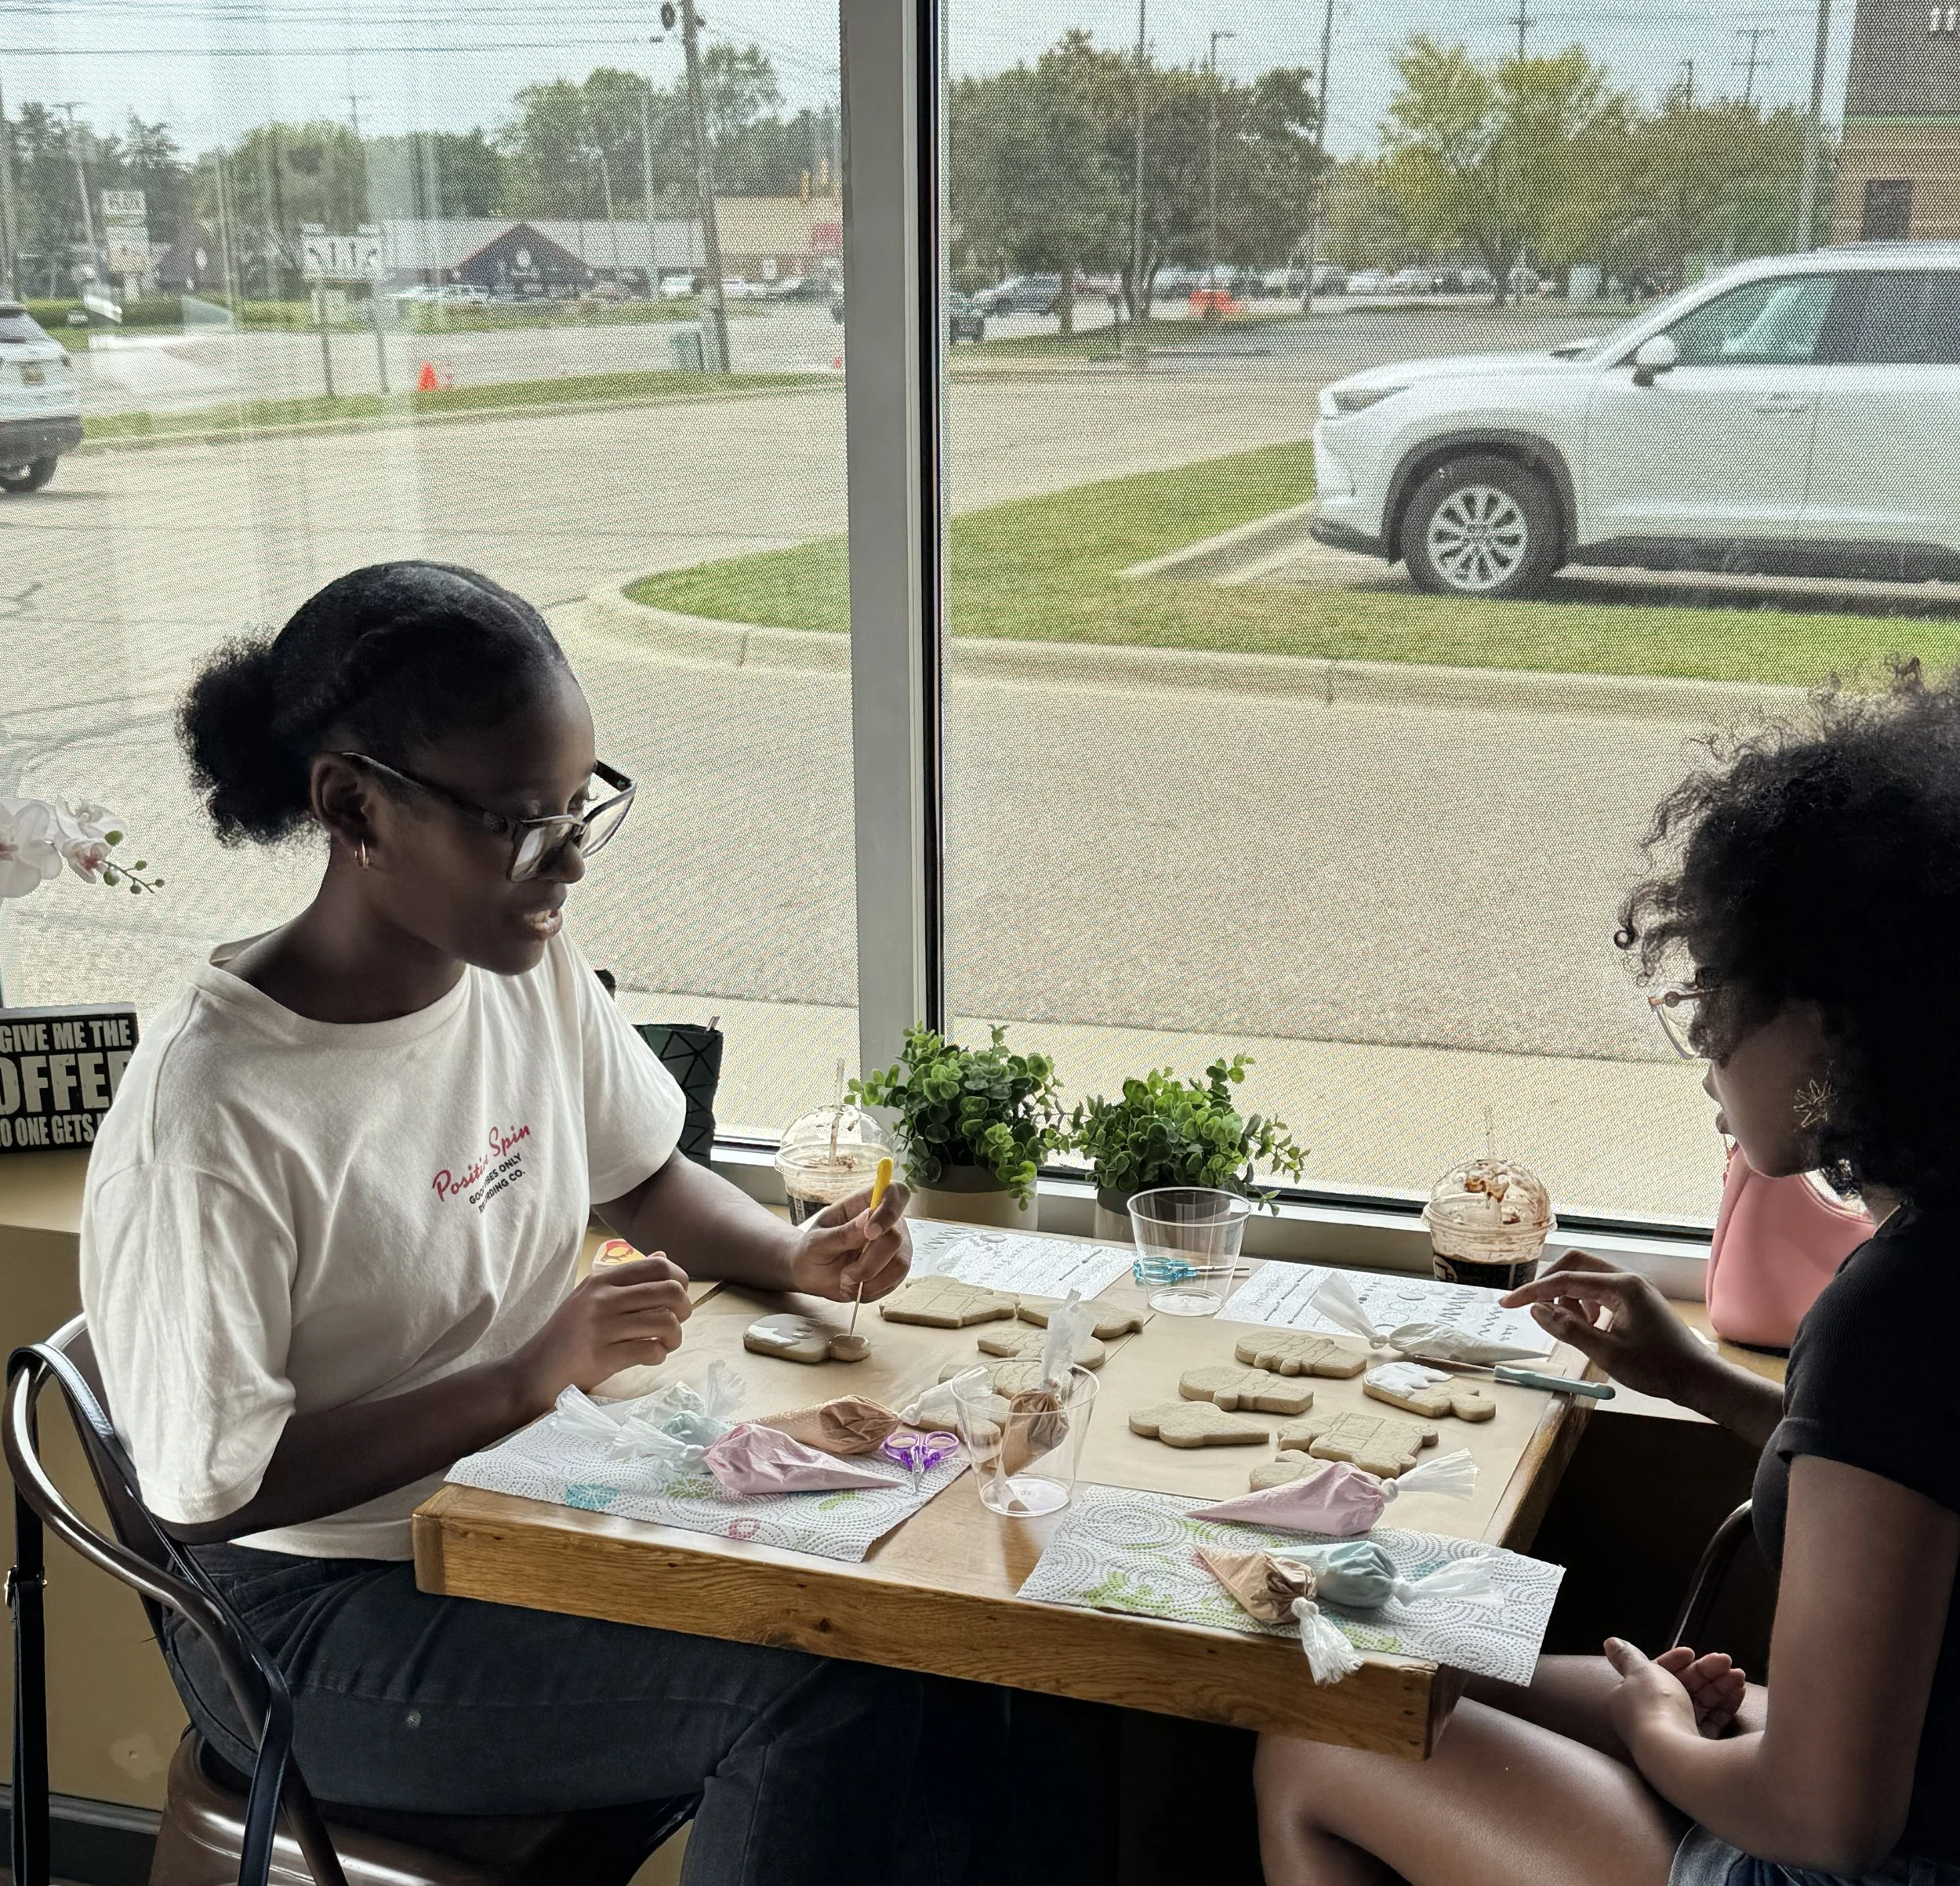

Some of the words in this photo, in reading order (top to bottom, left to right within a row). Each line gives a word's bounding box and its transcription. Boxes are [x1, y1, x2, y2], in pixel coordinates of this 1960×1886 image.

[0, 1025, 49, 1053] GIVE
[53, 1022, 86, 1050] ME
[89, 1020, 132, 1047] THE
[0, 1118, 13, 1147] O
[15, 1116, 50, 1146] ONE
[51, 1113, 95, 1144] GETS
[489, 1125, 530, 1157] Spin
[499, 1152, 522, 1173] ONLY
[509, 1170, 526, 1181] CO.
